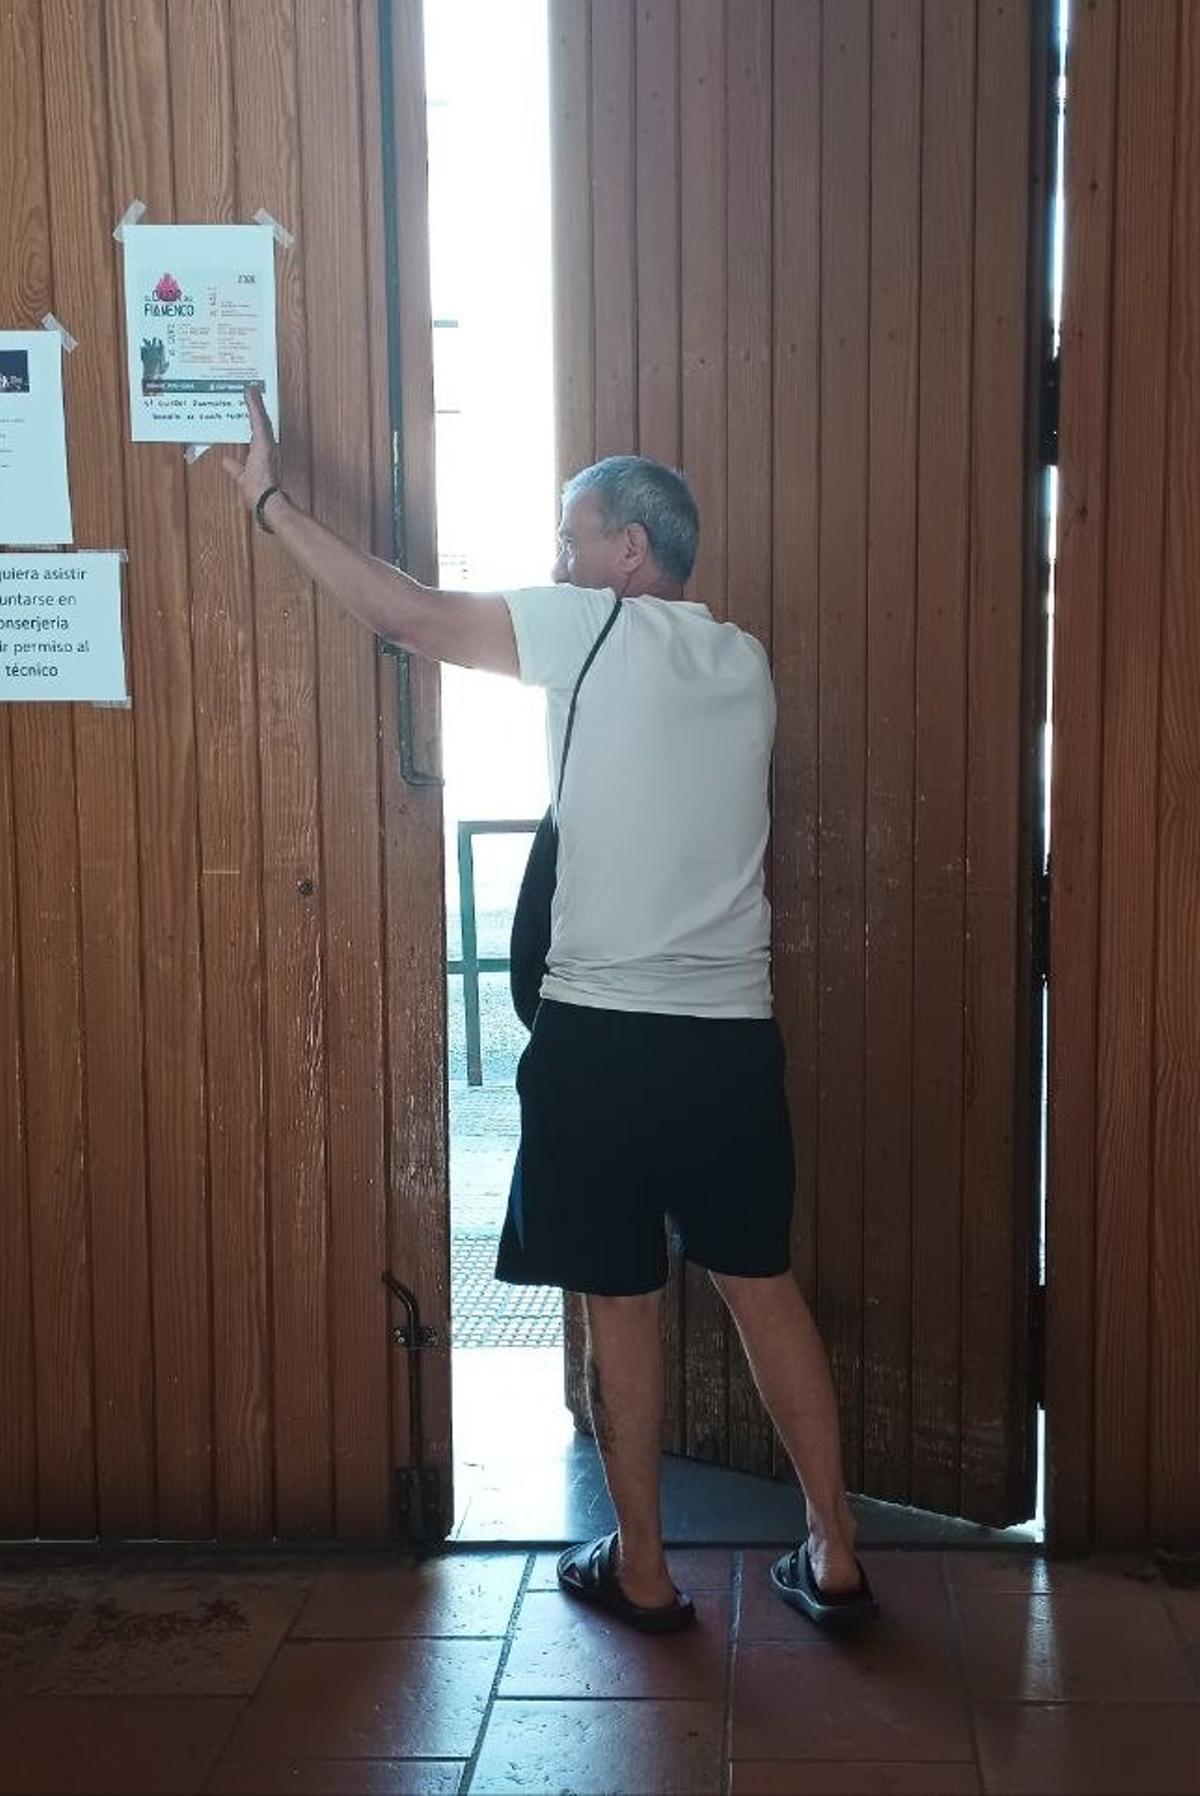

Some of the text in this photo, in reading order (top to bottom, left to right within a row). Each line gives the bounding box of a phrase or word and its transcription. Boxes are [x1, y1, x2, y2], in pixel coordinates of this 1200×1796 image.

[43, 568, 87, 580] asistir
[58, 595, 77, 606] en
[13, 641, 73, 656] permiso
[77, 640, 90, 653] al
[5, 662, 59, 677] técnico
